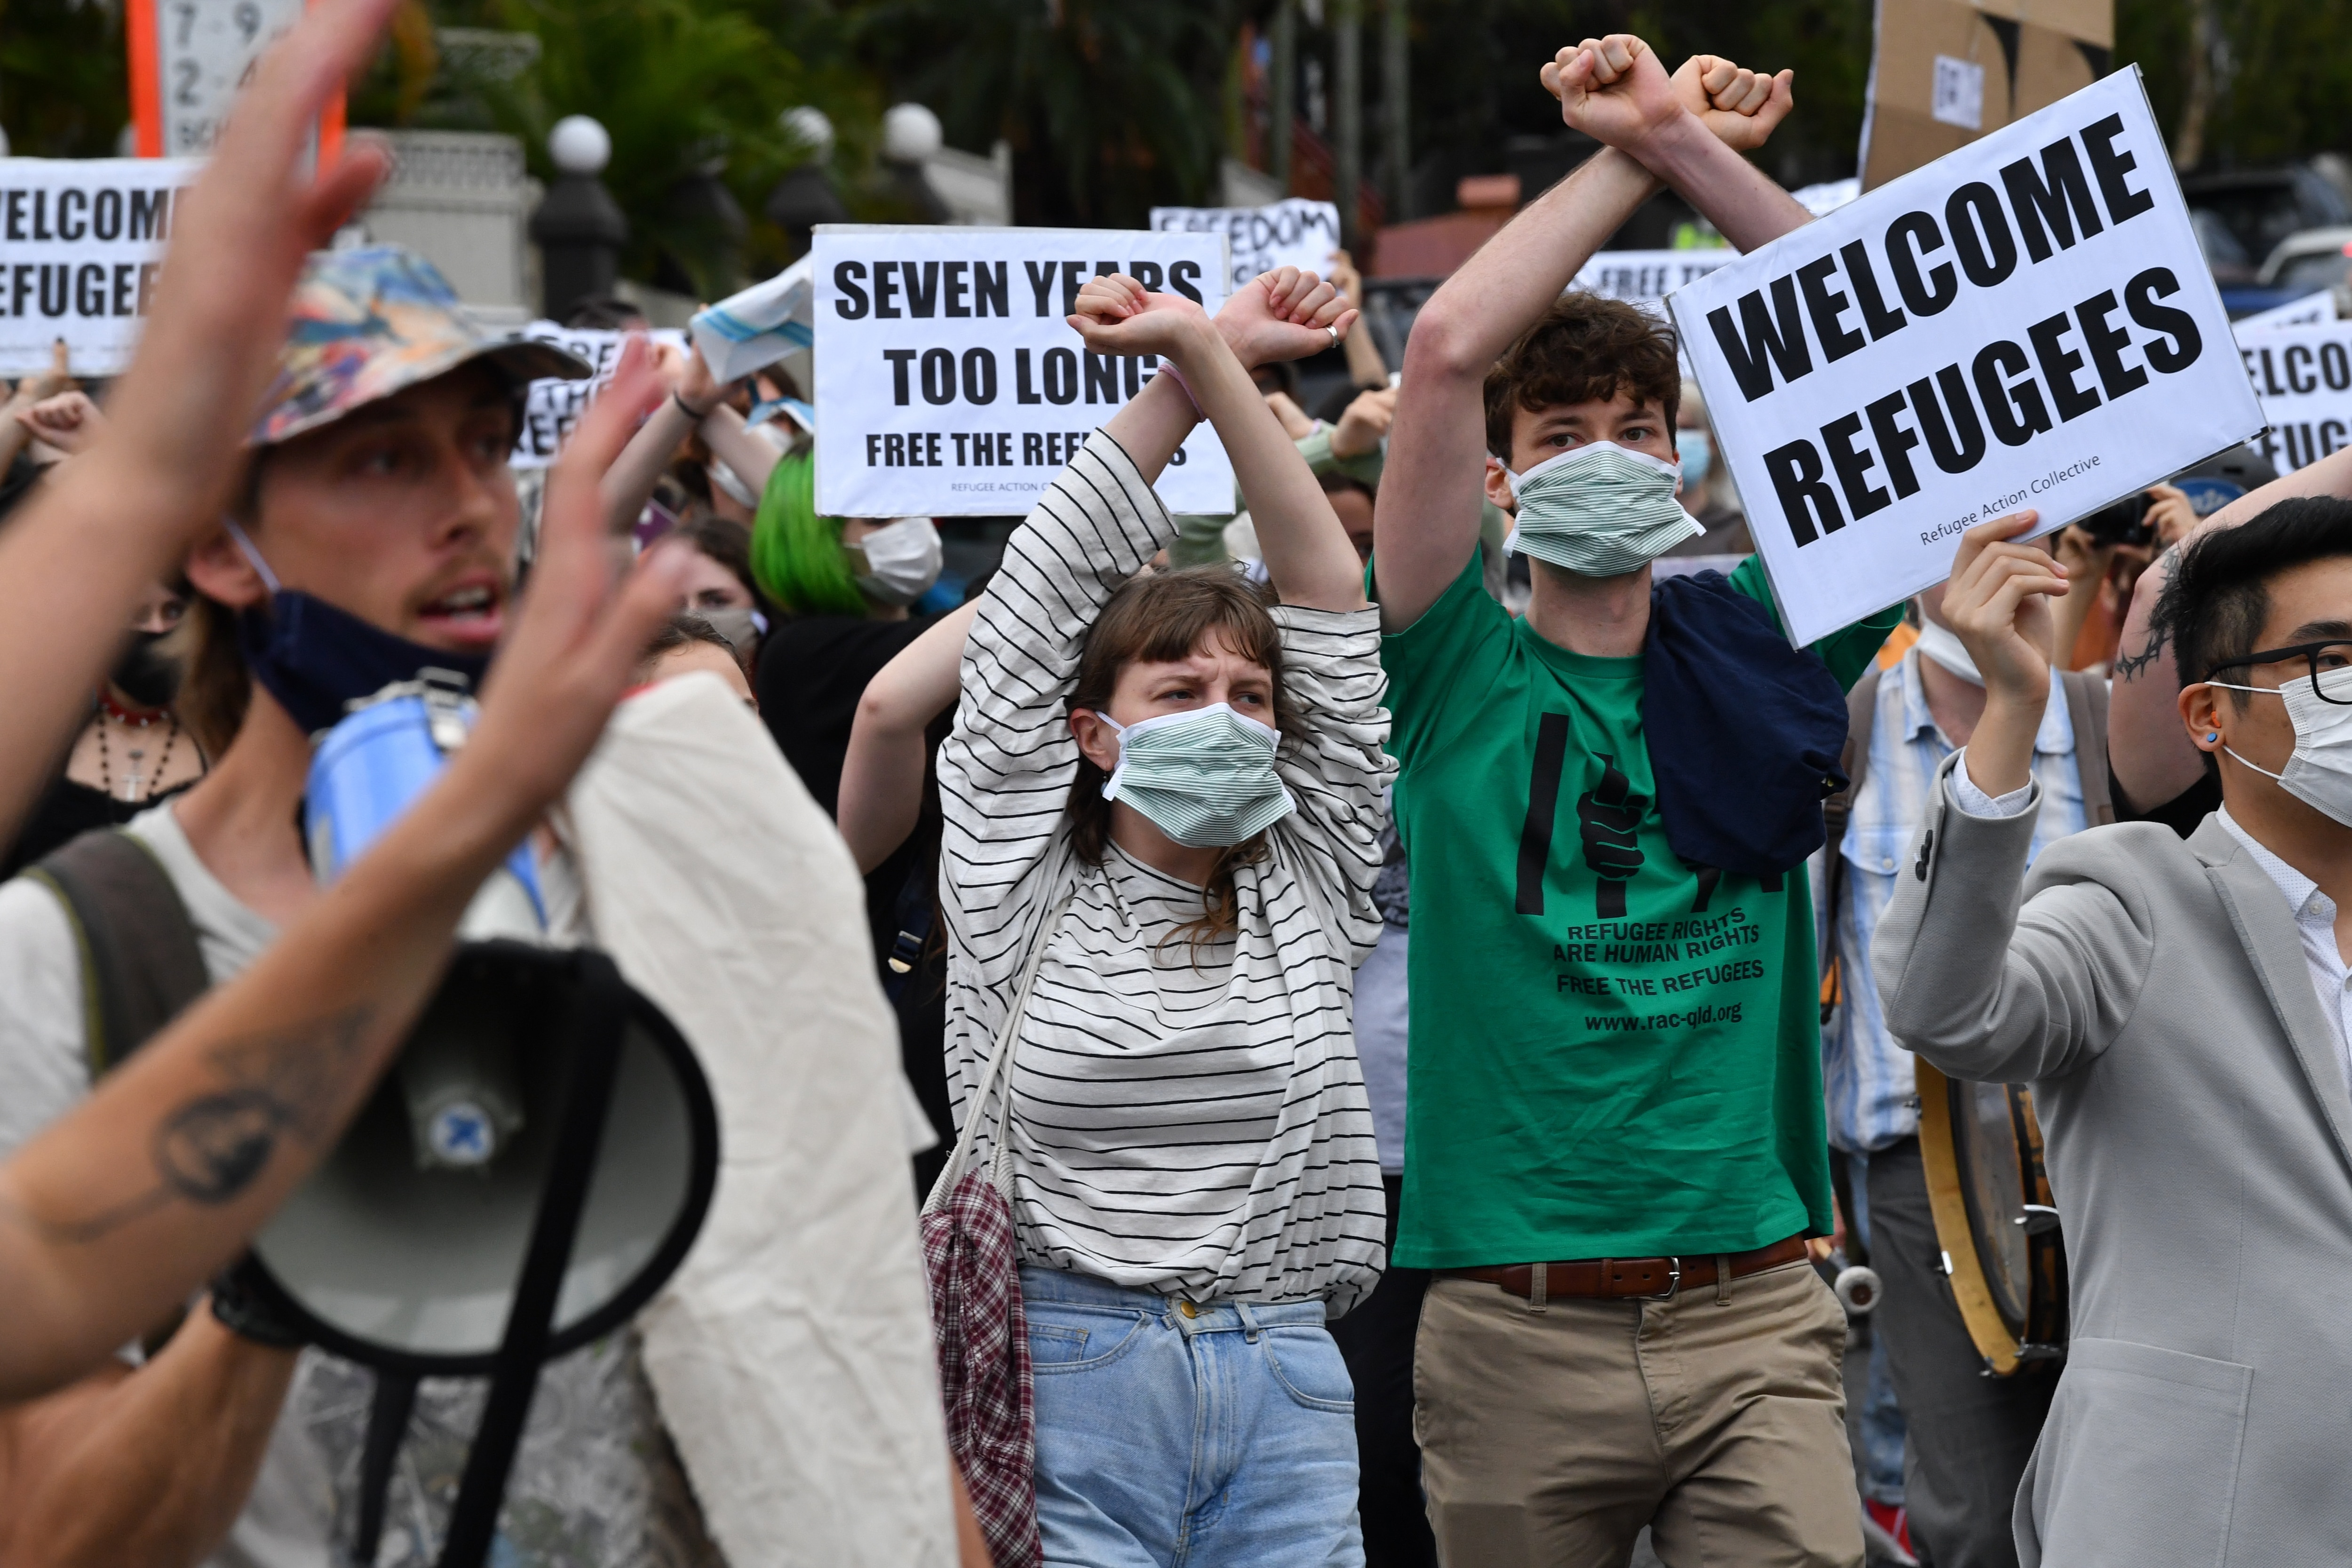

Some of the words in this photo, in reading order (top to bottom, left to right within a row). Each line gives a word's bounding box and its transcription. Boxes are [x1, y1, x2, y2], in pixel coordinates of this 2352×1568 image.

[174, 57, 199, 107] 2
[0, 189, 168, 241] ELCOM
[1706, 111, 2155, 403] WELCOME
[833, 260, 1009, 320] SEVEN
[1024, 260, 1203, 318] YERS
[883, 347, 997, 406] TOO
[1762, 266, 2203, 549] REFUGEES
[866, 433, 943, 467] FREE
[950, 433, 1013, 466] THE
[951, 483, 995, 492] REFUGEE
[999, 482, 1038, 491] ACTION
[1920, 512, 1979, 546] Refugee
[1983, 490, 2028, 517] Action
[2031, 455, 2101, 494] Collective
[1554, 943, 1597, 962] ARE
[1604, 943, 1680, 963] HUMAN
[1686, 924, 1759, 959] RIGHTS
[1568, 922, 1668, 941] REFUGEE
[1671, 907, 1746, 939] RIGHTS
[1557, 974, 1611, 995] FREE
[1615, 978, 1658, 996] THE
[1662, 959, 1764, 994] REFUGEES
[1585, 1002, 1742, 1031] www.rac-qld.org
